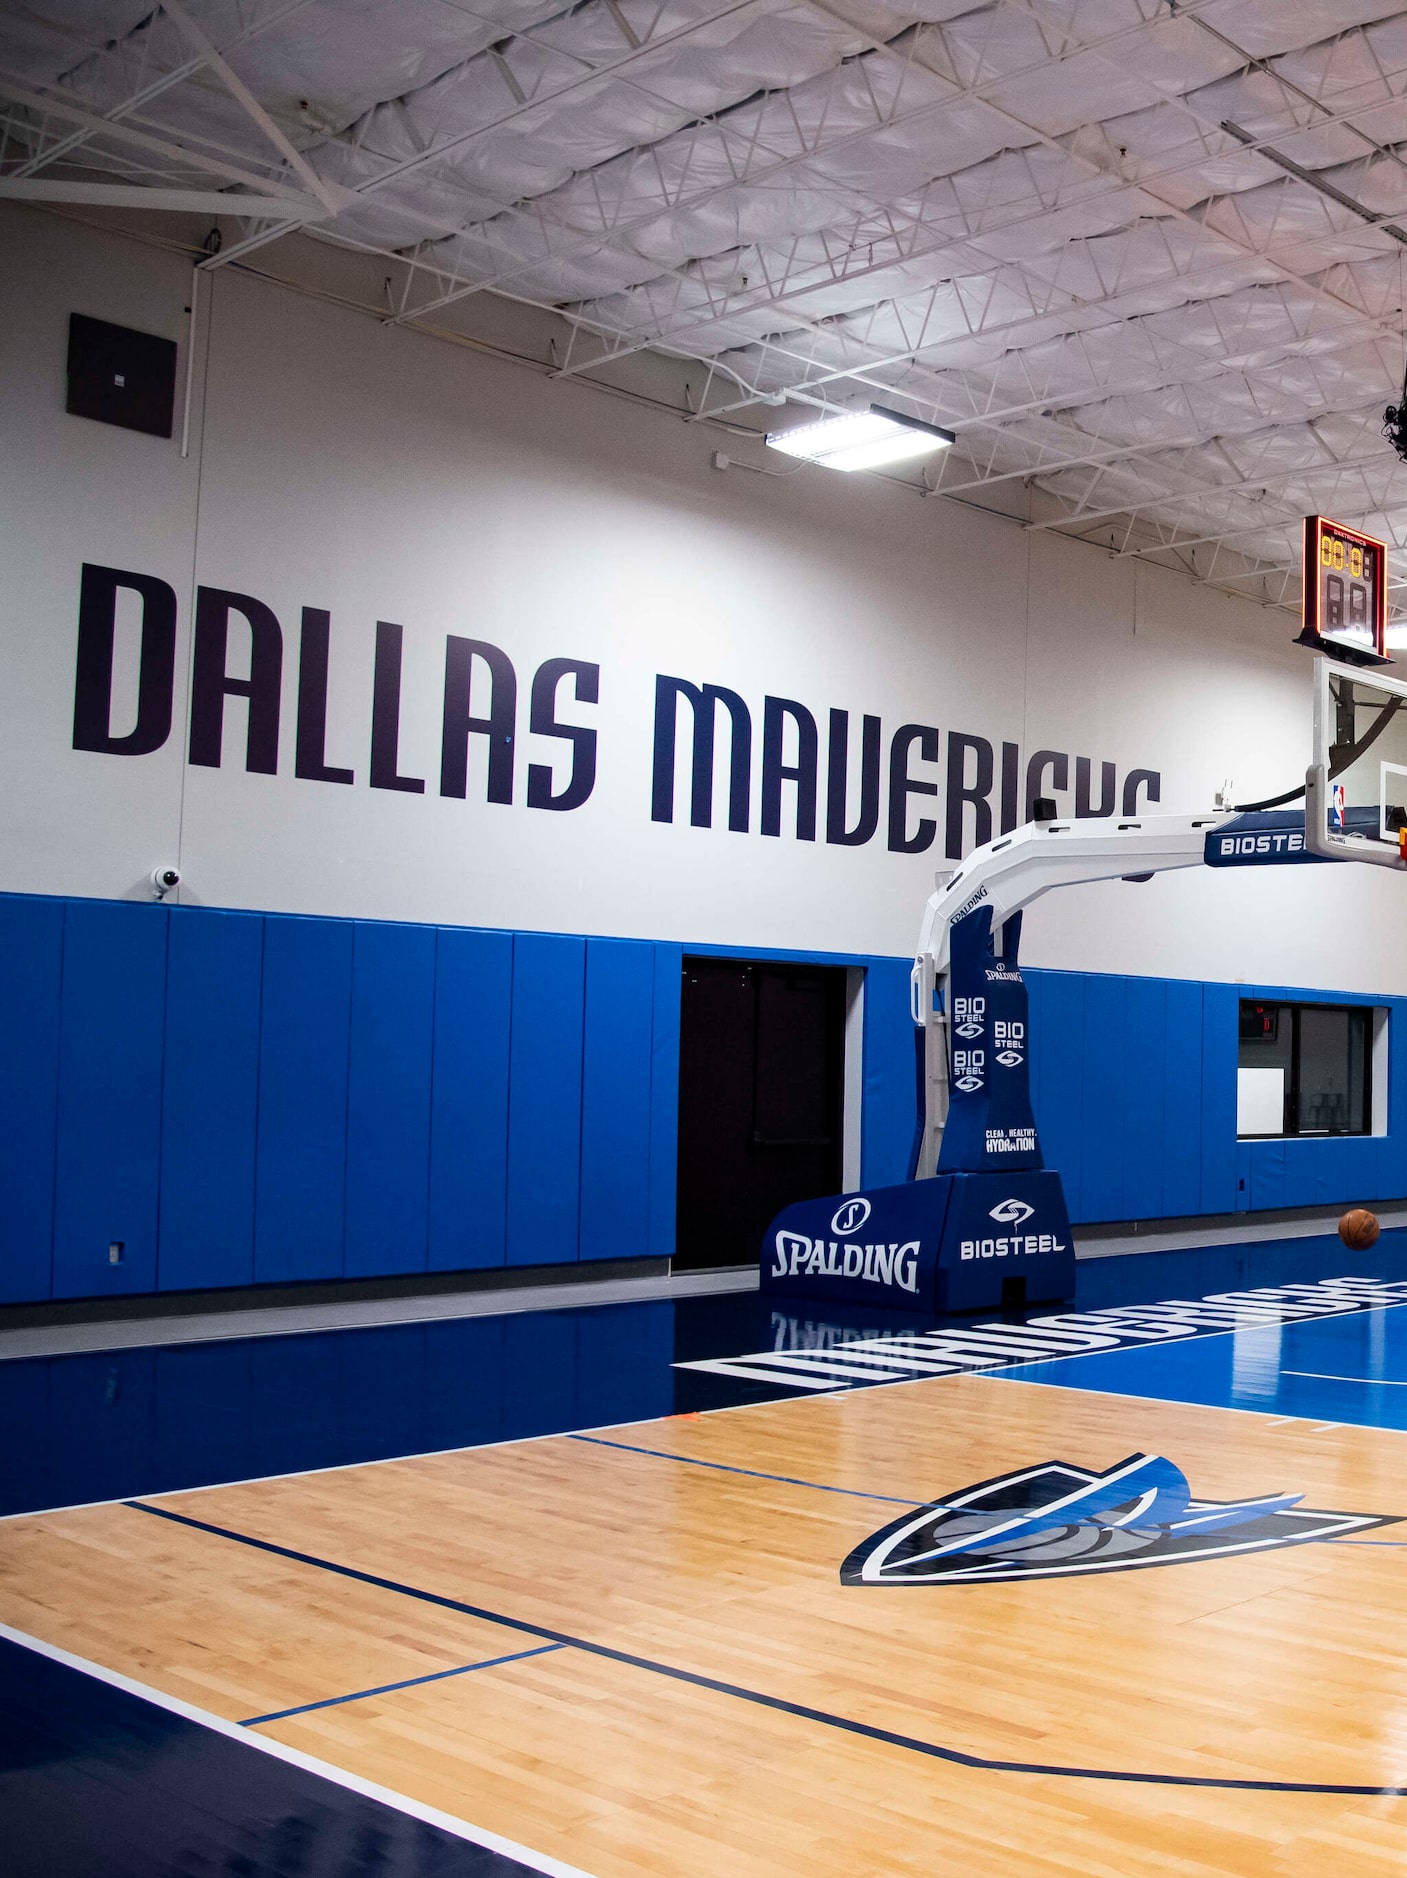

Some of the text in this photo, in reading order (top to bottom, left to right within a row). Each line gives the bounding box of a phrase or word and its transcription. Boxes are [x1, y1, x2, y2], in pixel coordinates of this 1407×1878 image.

[72, 562, 600, 811] DALLAS
[1220, 833, 1307, 856] BIOSTE
[949, 884, 989, 925] SPALDING
[985, 969, 1024, 983] SPALDING
[954, 997, 985, 1014] BIO
[954, 1014, 985, 1022] STEEL
[994, 1021, 1024, 1039] BIO
[994, 1039, 1024, 1048] STEEL
[954, 1050, 985, 1067] BIO
[954, 1067, 985, 1075] STEEL
[1009, 1128, 1037, 1137] HEALTHY.
[960, 1234, 1066, 1260] BIOSTEEL
[771, 1229, 921, 1293] SPALDING
